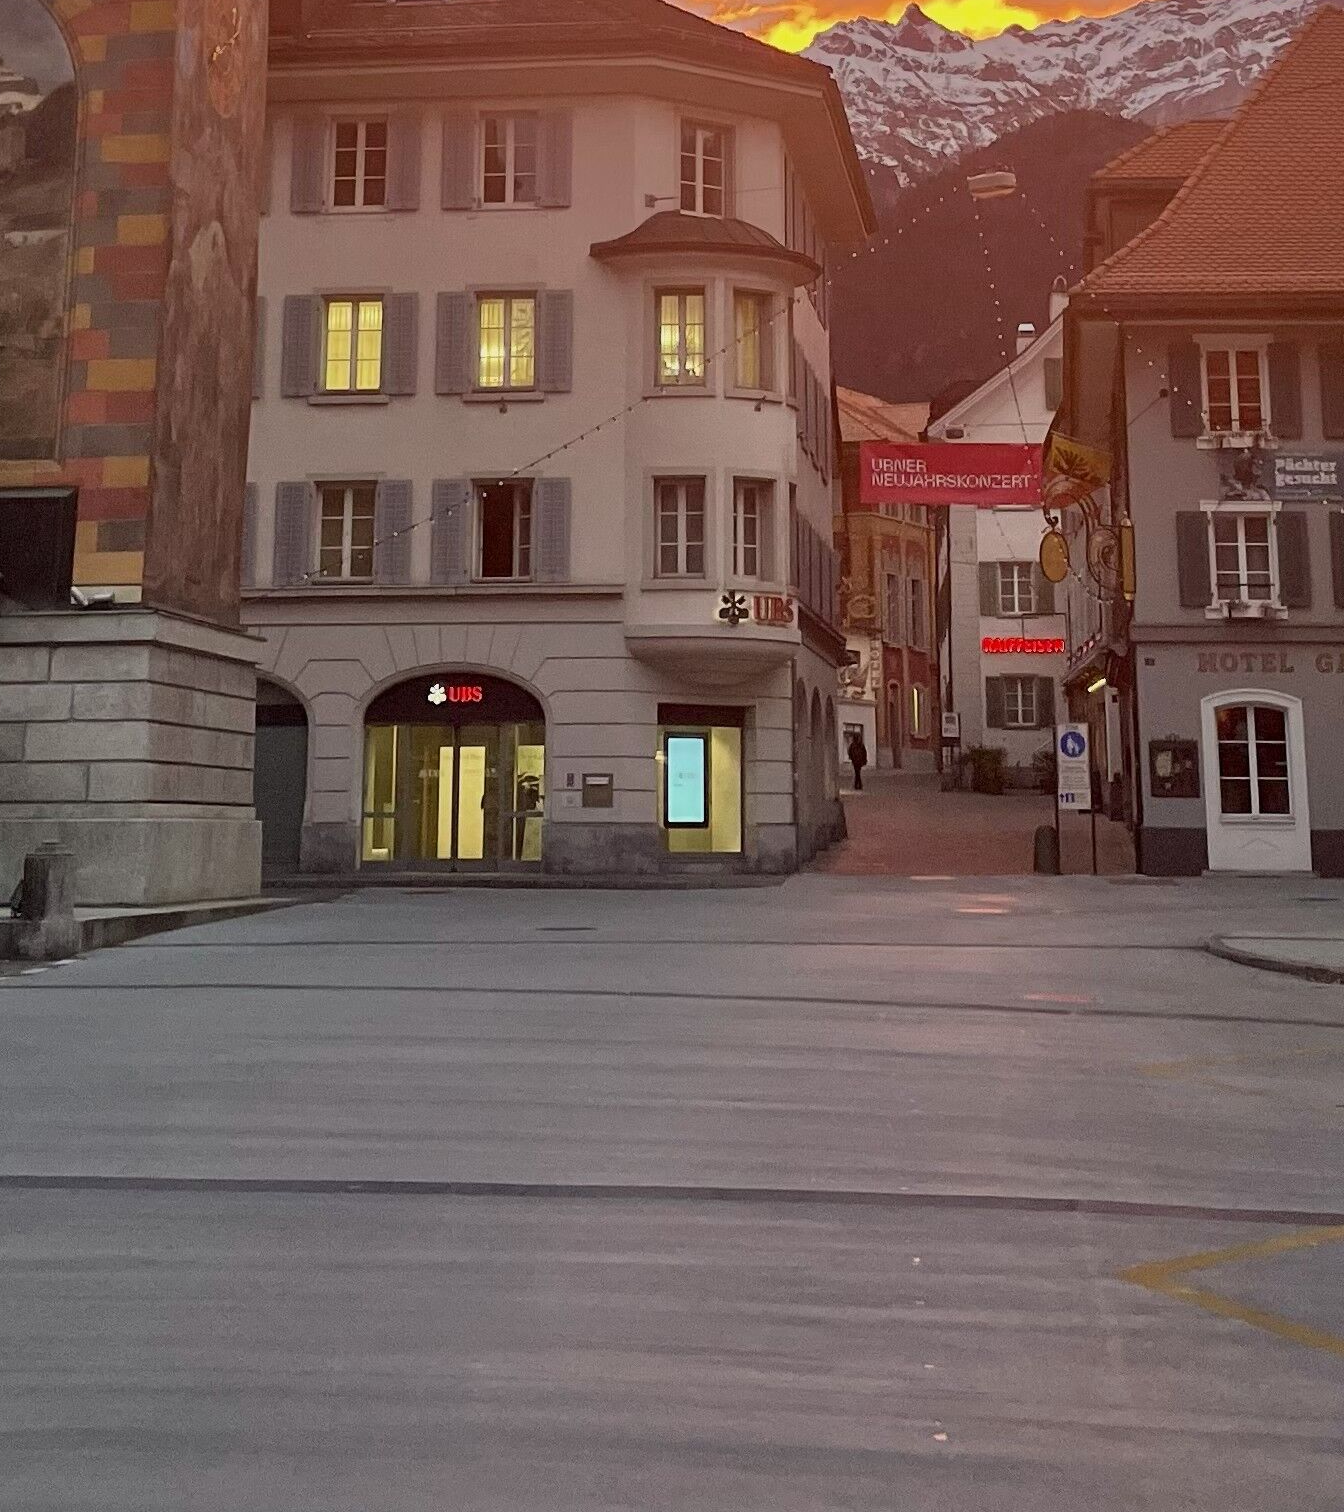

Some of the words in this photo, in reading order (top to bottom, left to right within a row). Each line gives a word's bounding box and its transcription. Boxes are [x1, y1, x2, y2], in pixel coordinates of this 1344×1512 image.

[871, 458, 927, 472] URNER
[871, 473, 1031, 488] NEUJAHRSKONZERT
[754, 595, 794, 624] UBS
[1197, 653, 1295, 673] HOTEL
[448, 686, 483, 702] UBS
